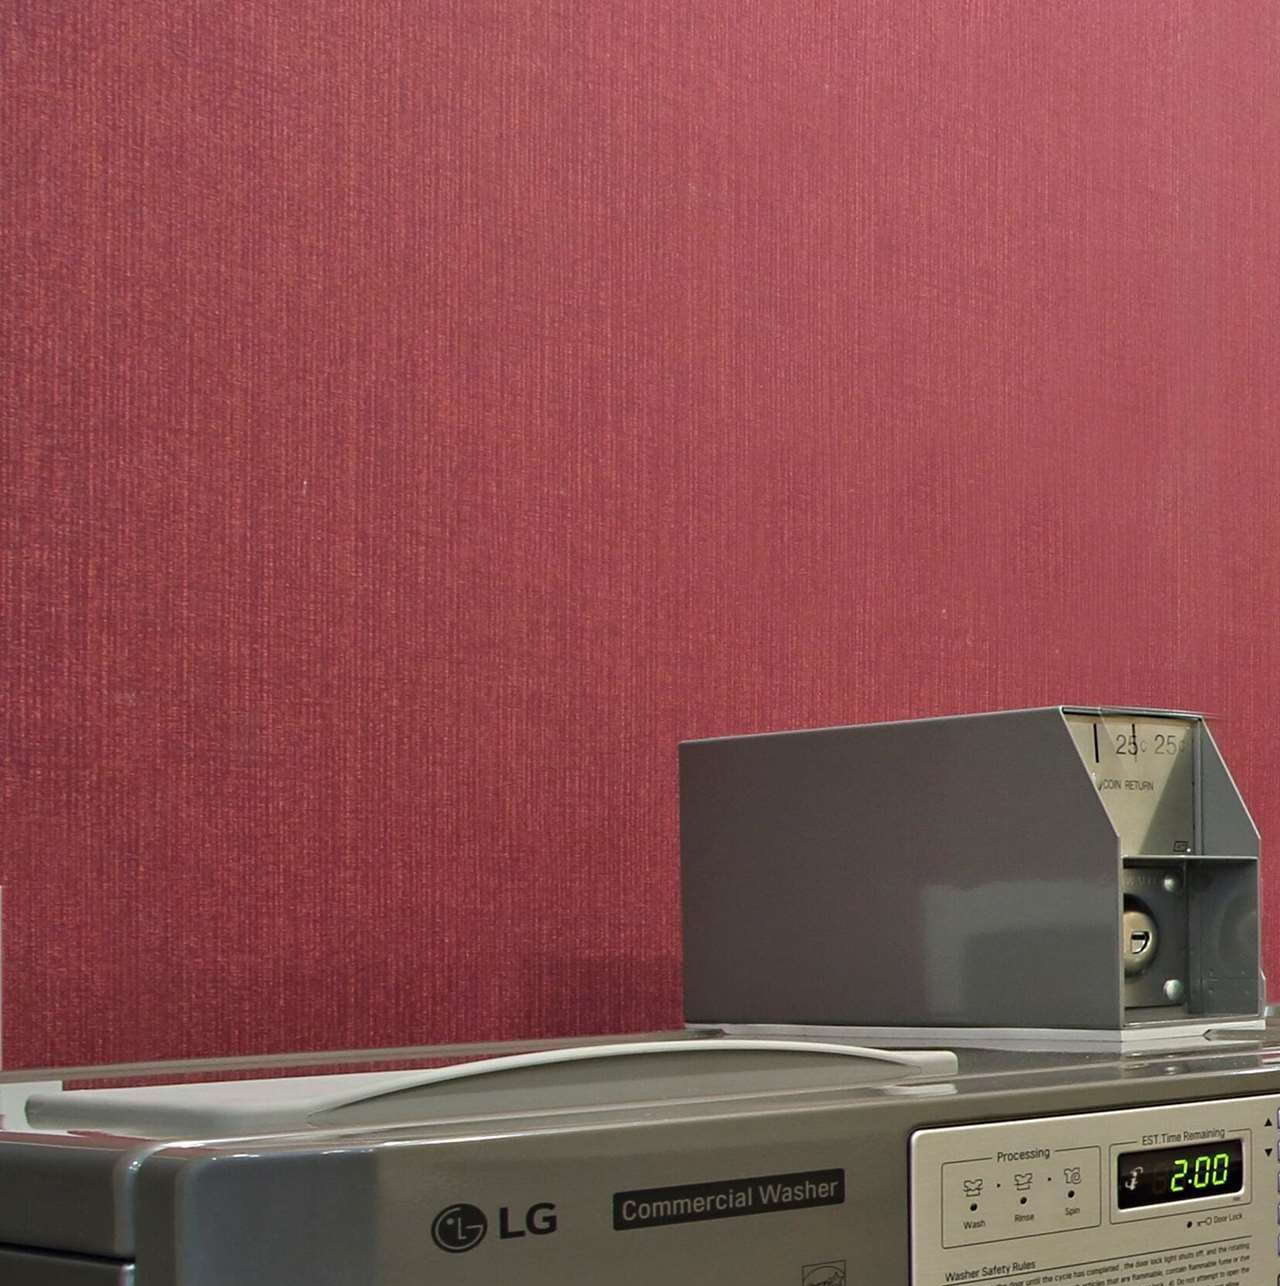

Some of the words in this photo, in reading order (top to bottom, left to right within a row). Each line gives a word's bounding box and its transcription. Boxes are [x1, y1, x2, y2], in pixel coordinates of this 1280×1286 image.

[1183, 1128, 1226, 1141] Remaining
[997, 1148, 1050, 1162] Processing
[622, 1187, 753, 1222] Commercial
[758, 1180, 839, 1205] Washer
[1065, 1207, 1081, 1216] Spin
[499, 1202, 558, 1239] LG
[963, 1219, 986, 1230] Wash
[1014, 1214, 1035, 1223] Rinse
[1214, 1215, 1227, 1224] Door
[1229, 1213, 1243, 1222] Lock
[944, 1268, 980, 1283] Washer
[982, 1264, 1011, 1277] Safety
[1012, 1260, 1036, 1272] Rules
[1042, 1275, 1052, 1283] the
